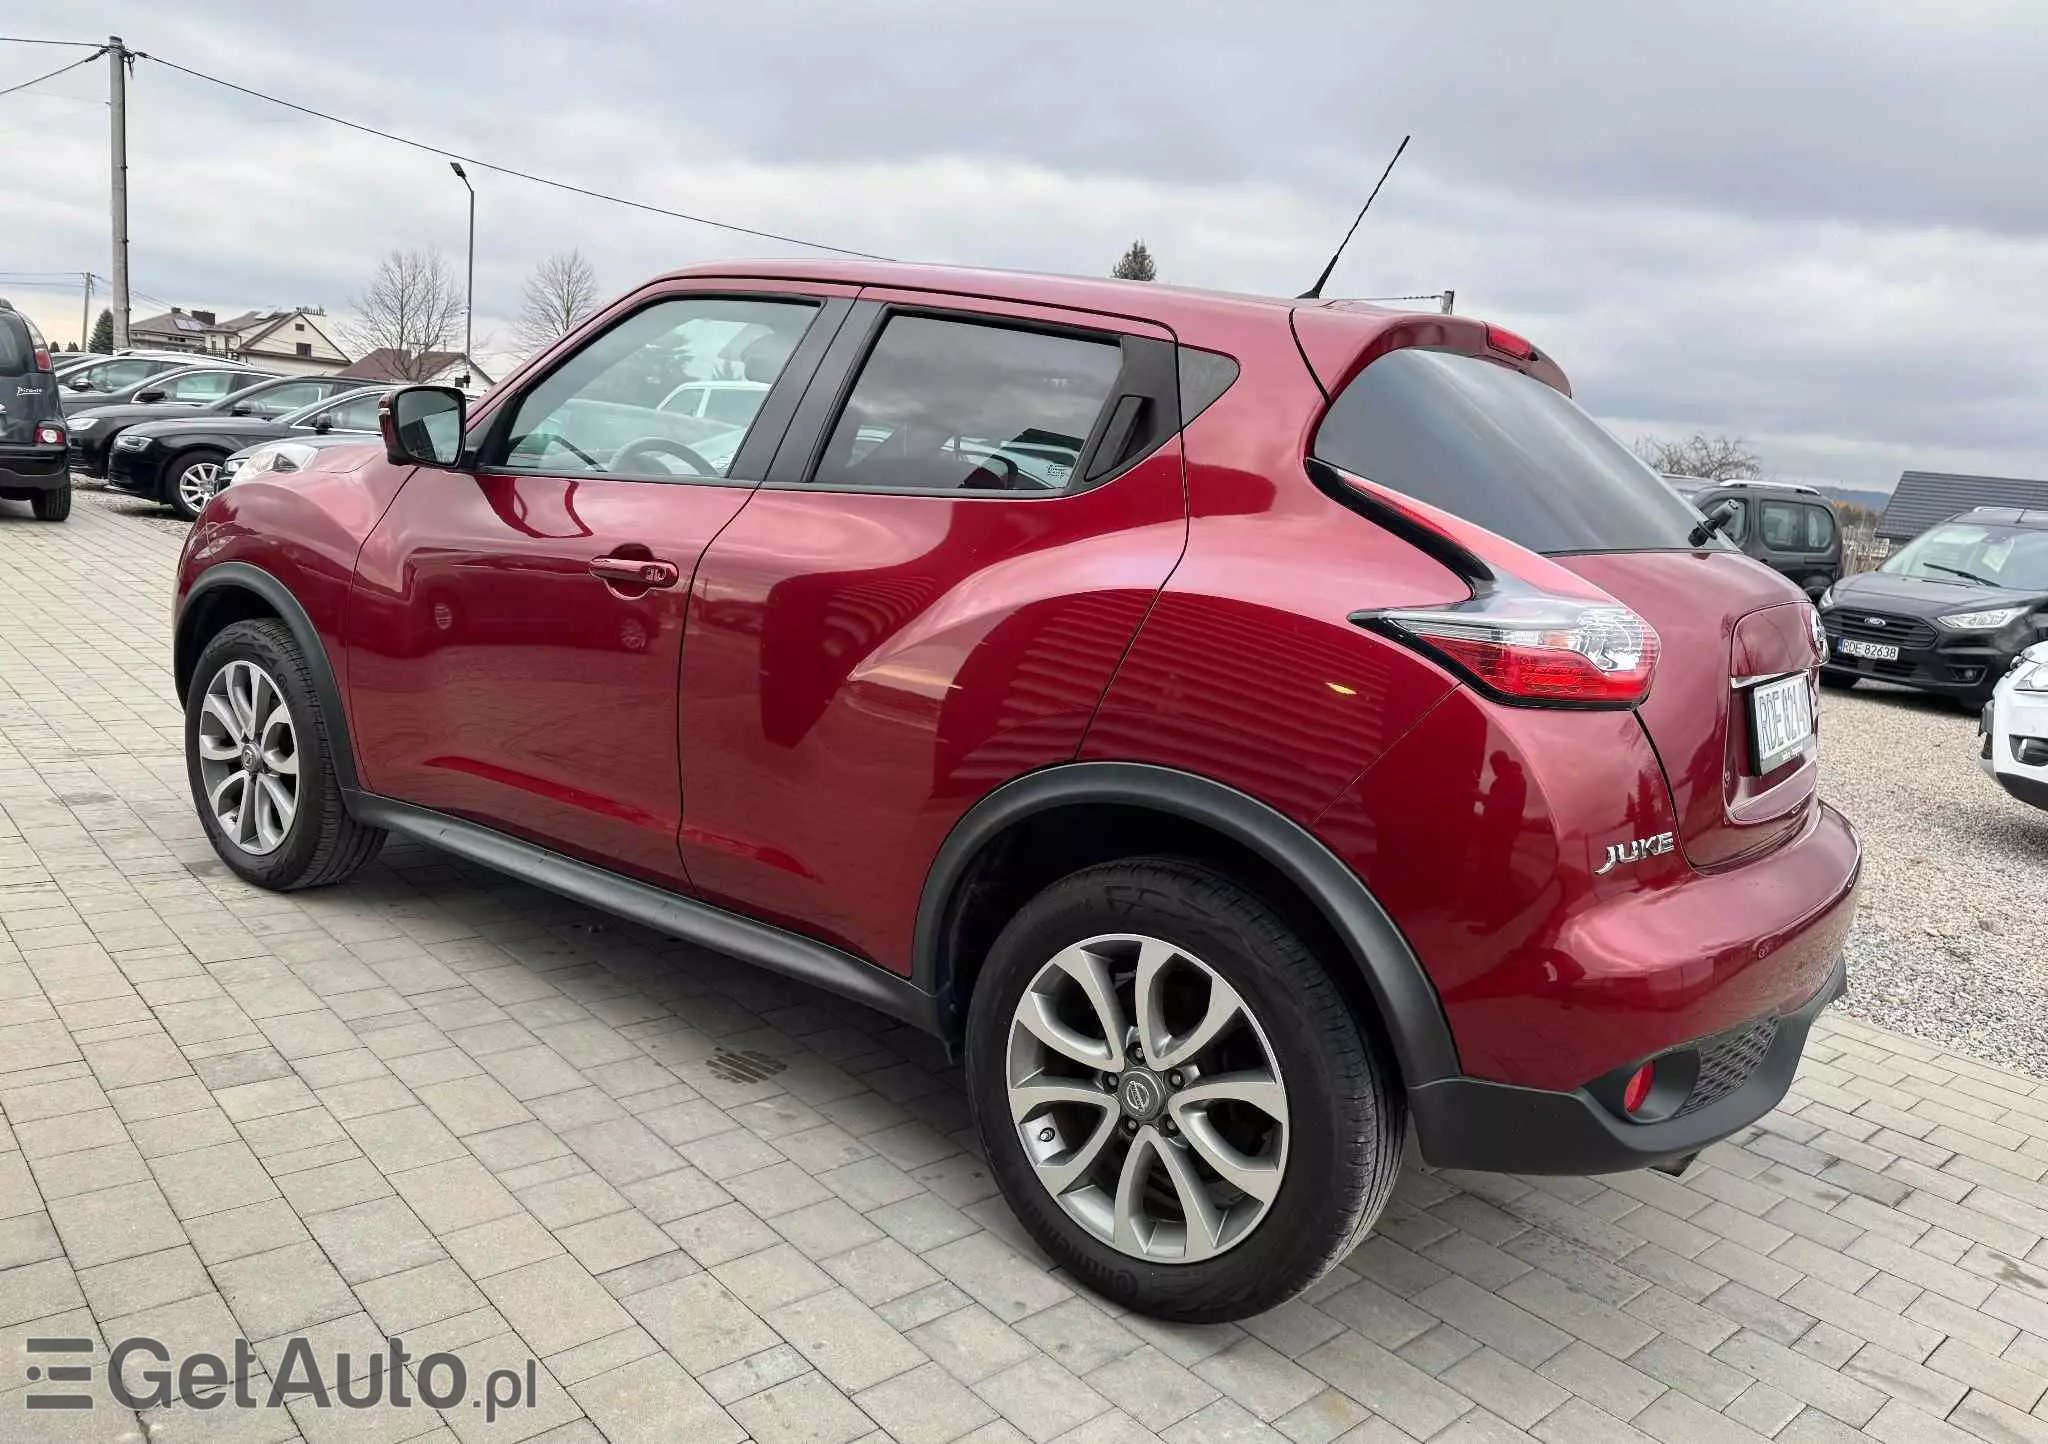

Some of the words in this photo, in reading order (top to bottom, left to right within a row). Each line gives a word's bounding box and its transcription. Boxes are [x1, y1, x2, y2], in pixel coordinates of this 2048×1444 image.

[1843, 640, 1862, 656] RDE
[1864, 644, 1897, 659] 82638
[1759, 690, 1784, 758] RDE
[1594, 831, 1676, 876] JUKE
